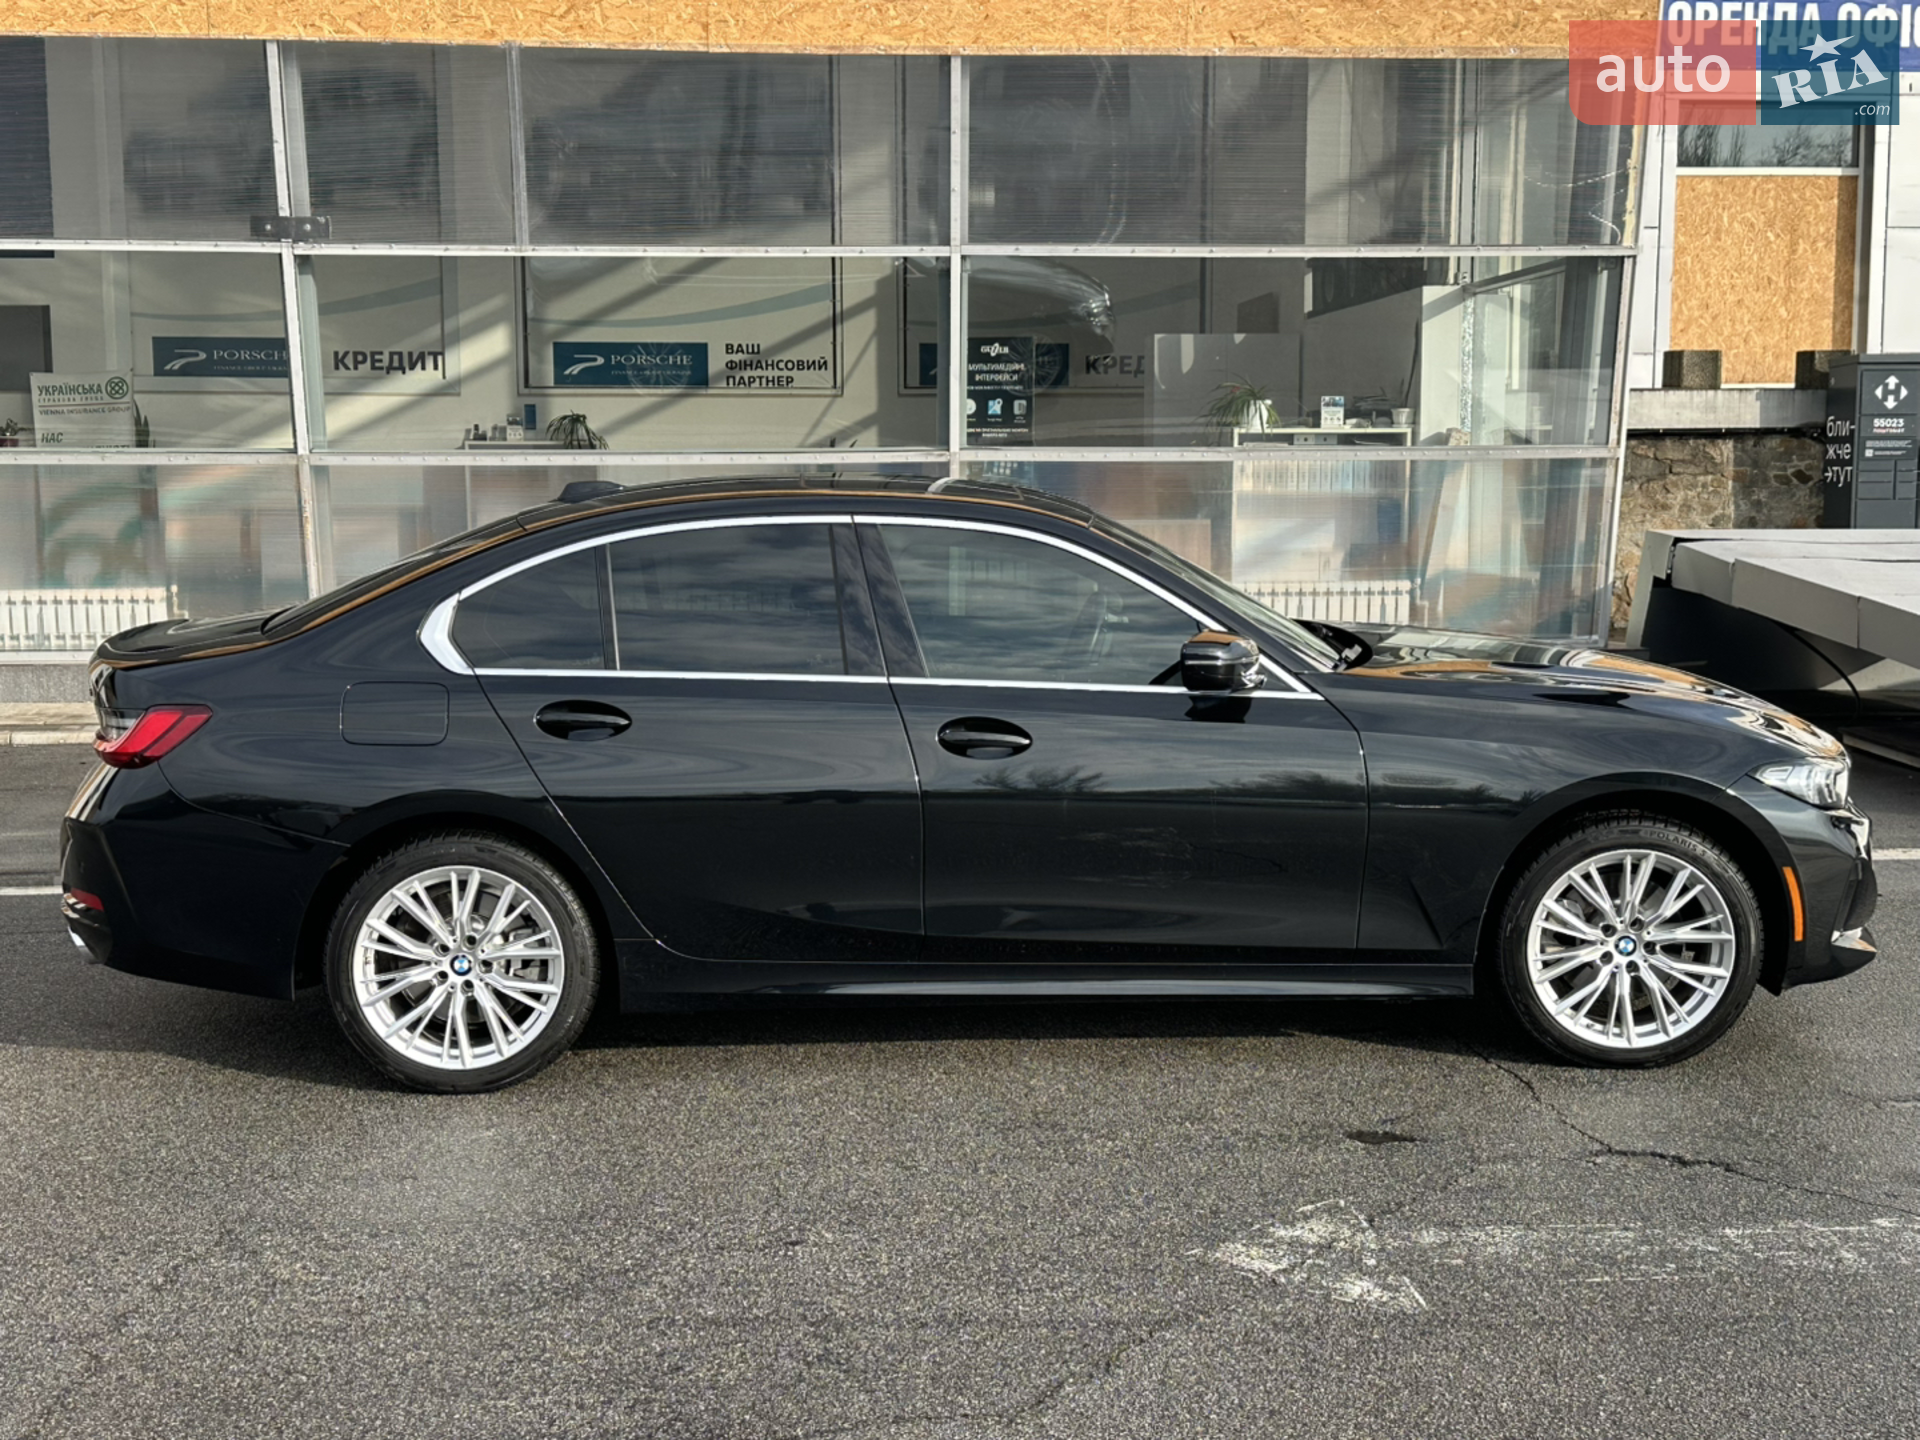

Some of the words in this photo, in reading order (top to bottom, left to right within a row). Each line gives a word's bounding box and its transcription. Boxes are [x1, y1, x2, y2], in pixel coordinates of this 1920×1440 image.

[1667, 1, 1822, 55] ОРЕНДА
[725, 343, 760, 355] ВАШ
[333, 350, 445, 374] КРЕДИТ
[611, 354, 692, 365] PORSCHE
[725, 357, 828, 372] ФІНАНСОВИЙ
[725, 375, 794, 388] ПАРТНЕР
[37, 382, 103, 397] УКРАЇНСЬКА
[1826, 416, 1855, 437] бли-
[1873, 418, 1904, 428] 55023
[1826, 443, 1851, 459] жче
[1832, 466, 1853, 487] тут
[1649, 830, 1698, 852] POLARIS
